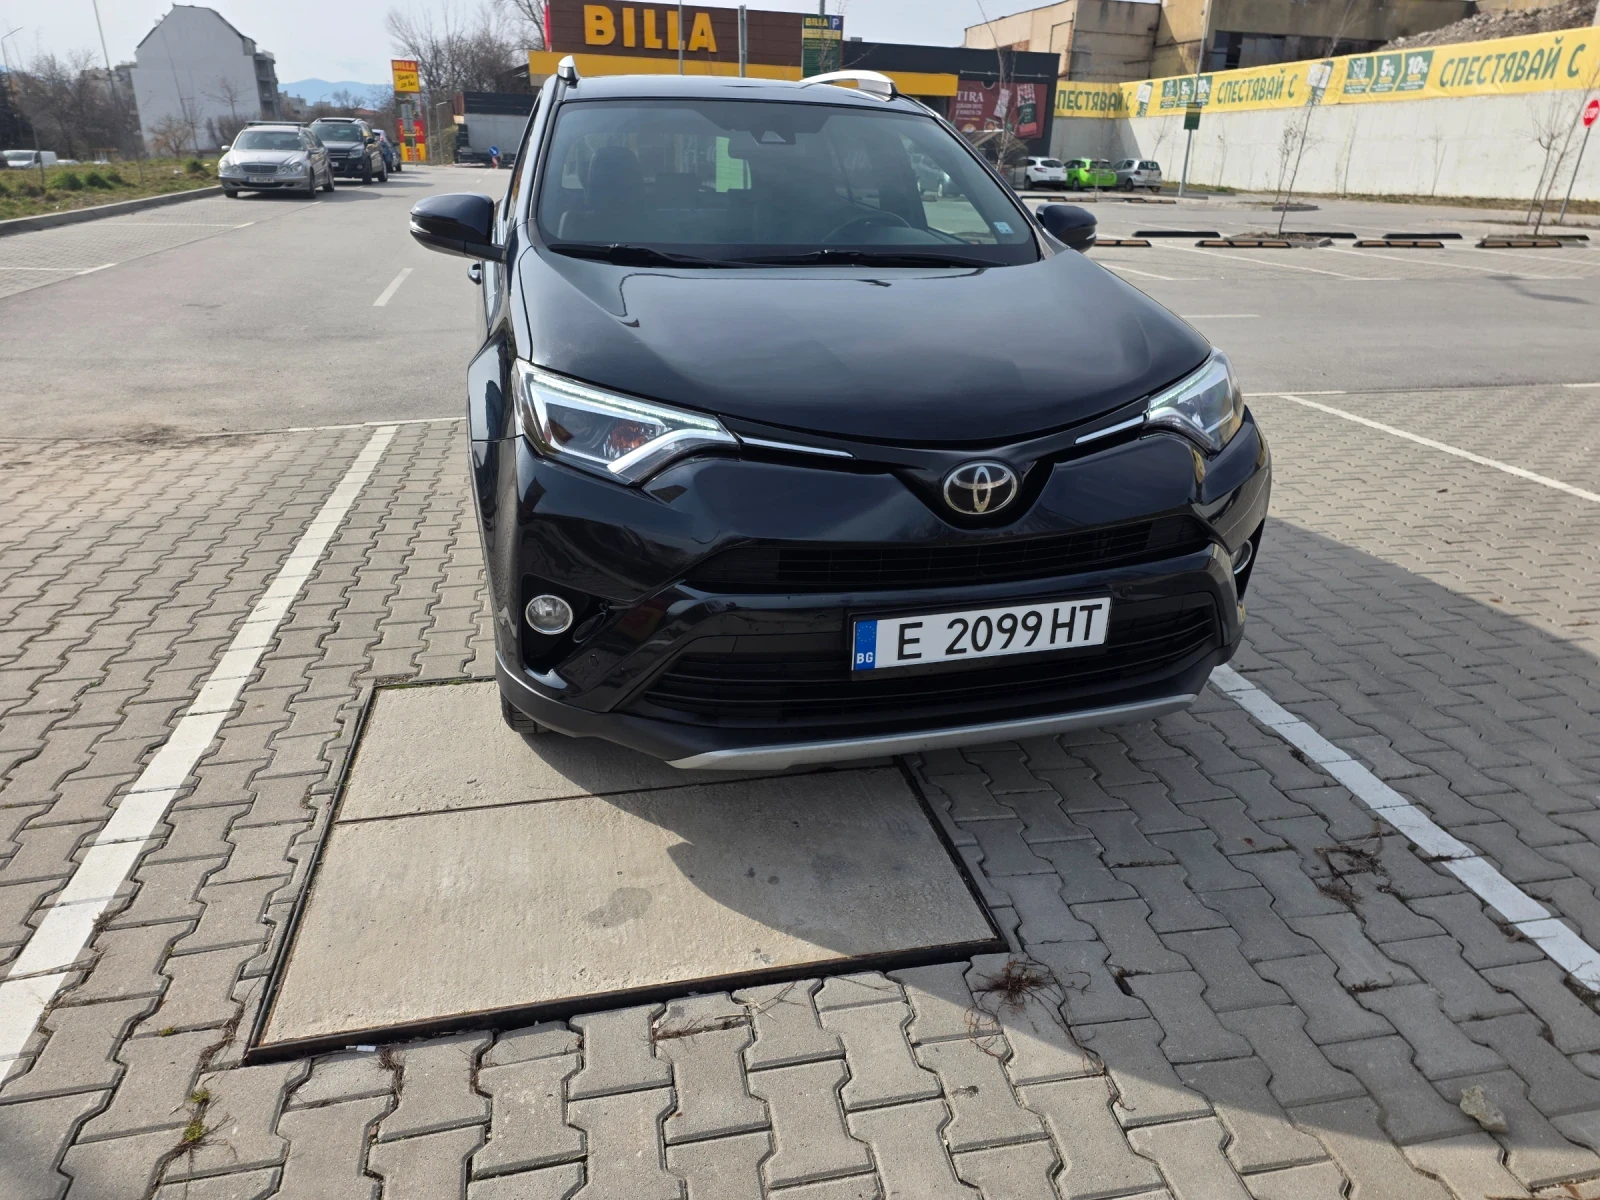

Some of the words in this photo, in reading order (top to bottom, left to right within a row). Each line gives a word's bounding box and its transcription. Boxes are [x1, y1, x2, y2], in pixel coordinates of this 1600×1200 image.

[583, 4, 717, 52] BILLA
[805, 17, 828, 27] BILLA
[393, 61, 416, 71] BILLA
[1380, 58, 1395, 77] 5%
[1407, 56, 1428, 75] 10%
[1439, 36, 1564, 88] СПЕСТЯВАЙ
[1217, 68, 1286, 104] СПЕСТЯВАЙ
[957, 91, 984, 103] TIRA
[1055, 88, 1123, 112] ПЕСТЯВАЙ
[897, 621, 923, 661] E
[856, 651, 874, 664] BG
